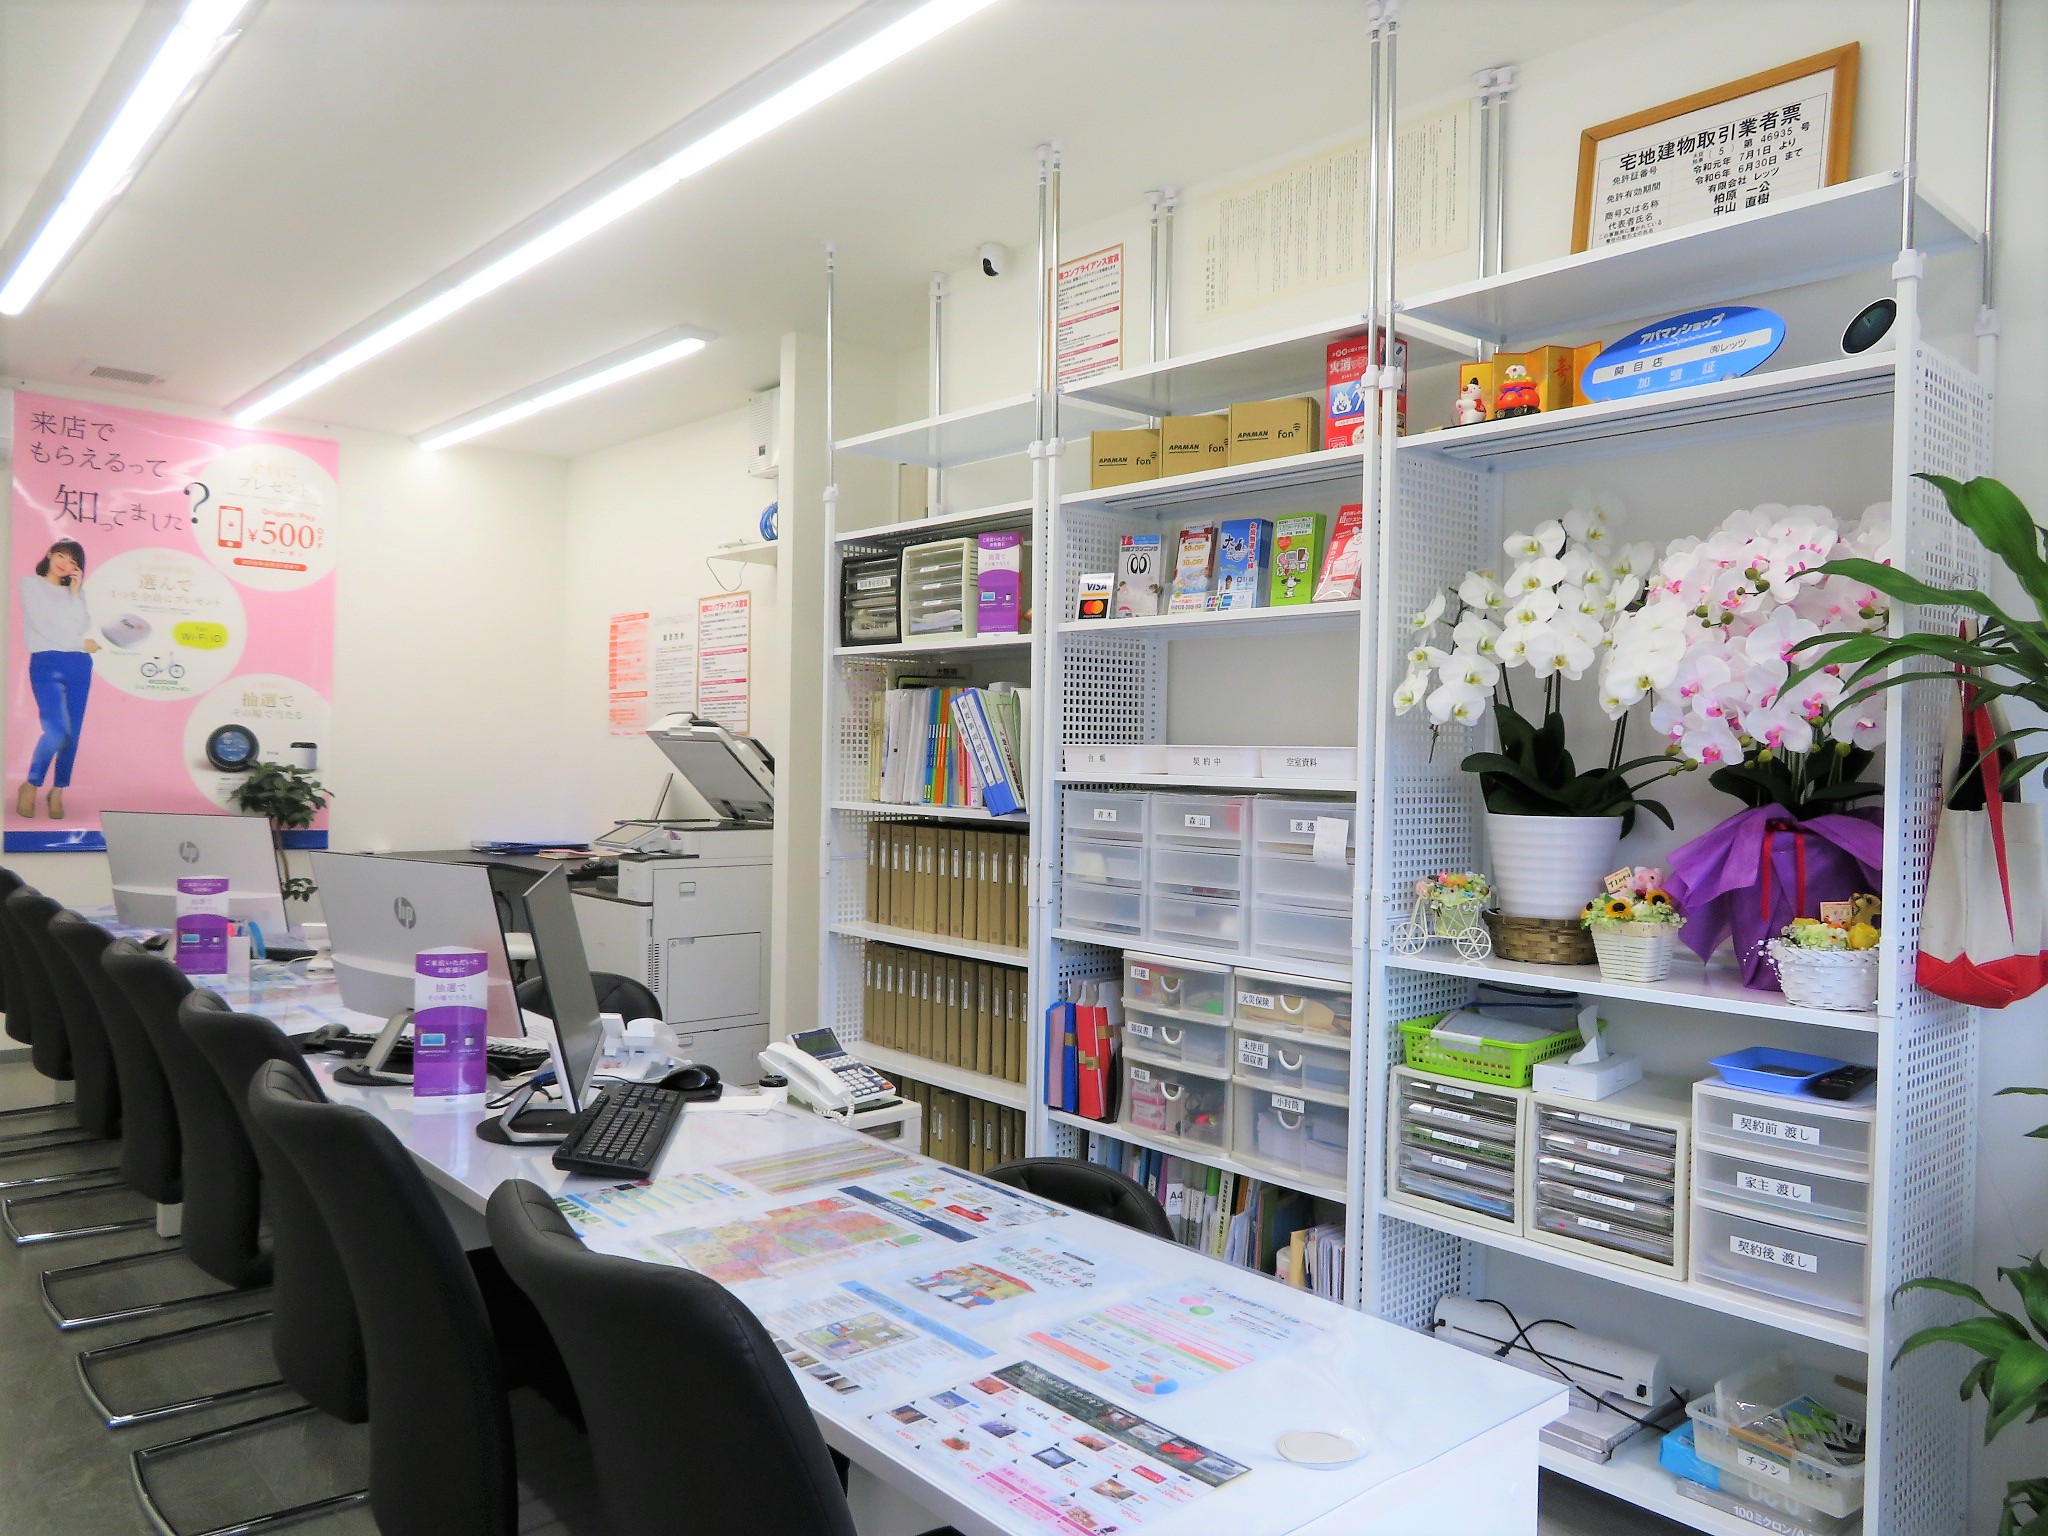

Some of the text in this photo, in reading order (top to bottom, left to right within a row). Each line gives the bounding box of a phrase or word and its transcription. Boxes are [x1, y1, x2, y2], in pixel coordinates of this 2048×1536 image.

[1620, 103, 1801, 171] 宅地建物取引業者票
[1612, 166, 1657, 186] 免許証番号
[1760, 127, 1793, 143] 46935
[1801, 121, 1810, 132] 号
[1693, 138, 1796, 175] 令和元年 7月1日 より
[1606, 148, 1803, 204] 免許有効期間 令和6年 6月30日 まで
[1604, 167, 1780, 221] 商号又は名称 有限会社 レッツ
[1608, 181, 1771, 231] 代表者氏名 柏原 一公
[1713, 201, 1736, 216] 中山
[1745, 191, 1770, 209] 直樹
[1640, 313, 1726, 345] アパマンショップ
[31, 410, 116, 442] 来店で
[1237, 429, 1294, 439] APAMAN fon
[1168, 443, 1224, 453] APAMAN fon
[31, 441, 167, 478] もらえるって
[1098, 456, 1151, 465] APAMAN fon
[1087, 583, 1107, 591] VISA
[242, 691, 294, 707] 抽選で
[1192, 756, 1221, 767] 契約中
[1286, 757, 1318, 768] 空室資料
[1188, 816, 1206, 826] 森山
[1133, 968, 1147, 979] 印鑑
[435, 982, 466, 993] 抽選で
[1241, 994, 1270, 1008] 火災保険
[1131, 1024, 1150, 1036] 領収書
[1243, 1039, 1265, 1053] 未使用
[1242, 1054, 1264, 1067] 領収書
[1133, 1069, 1147, 1080] 備品
[1276, 1097, 1300, 1111] 小封筒
[1740, 1117, 1810, 1141] 契約前 渡し
[1745, 1176, 1802, 1199] 家主 渡し
[1170, 1191, 1183, 1200] A4
[1738, 1240, 1807, 1268] 契約後 渡し
[1745, 1456, 1781, 1476] チラシ
